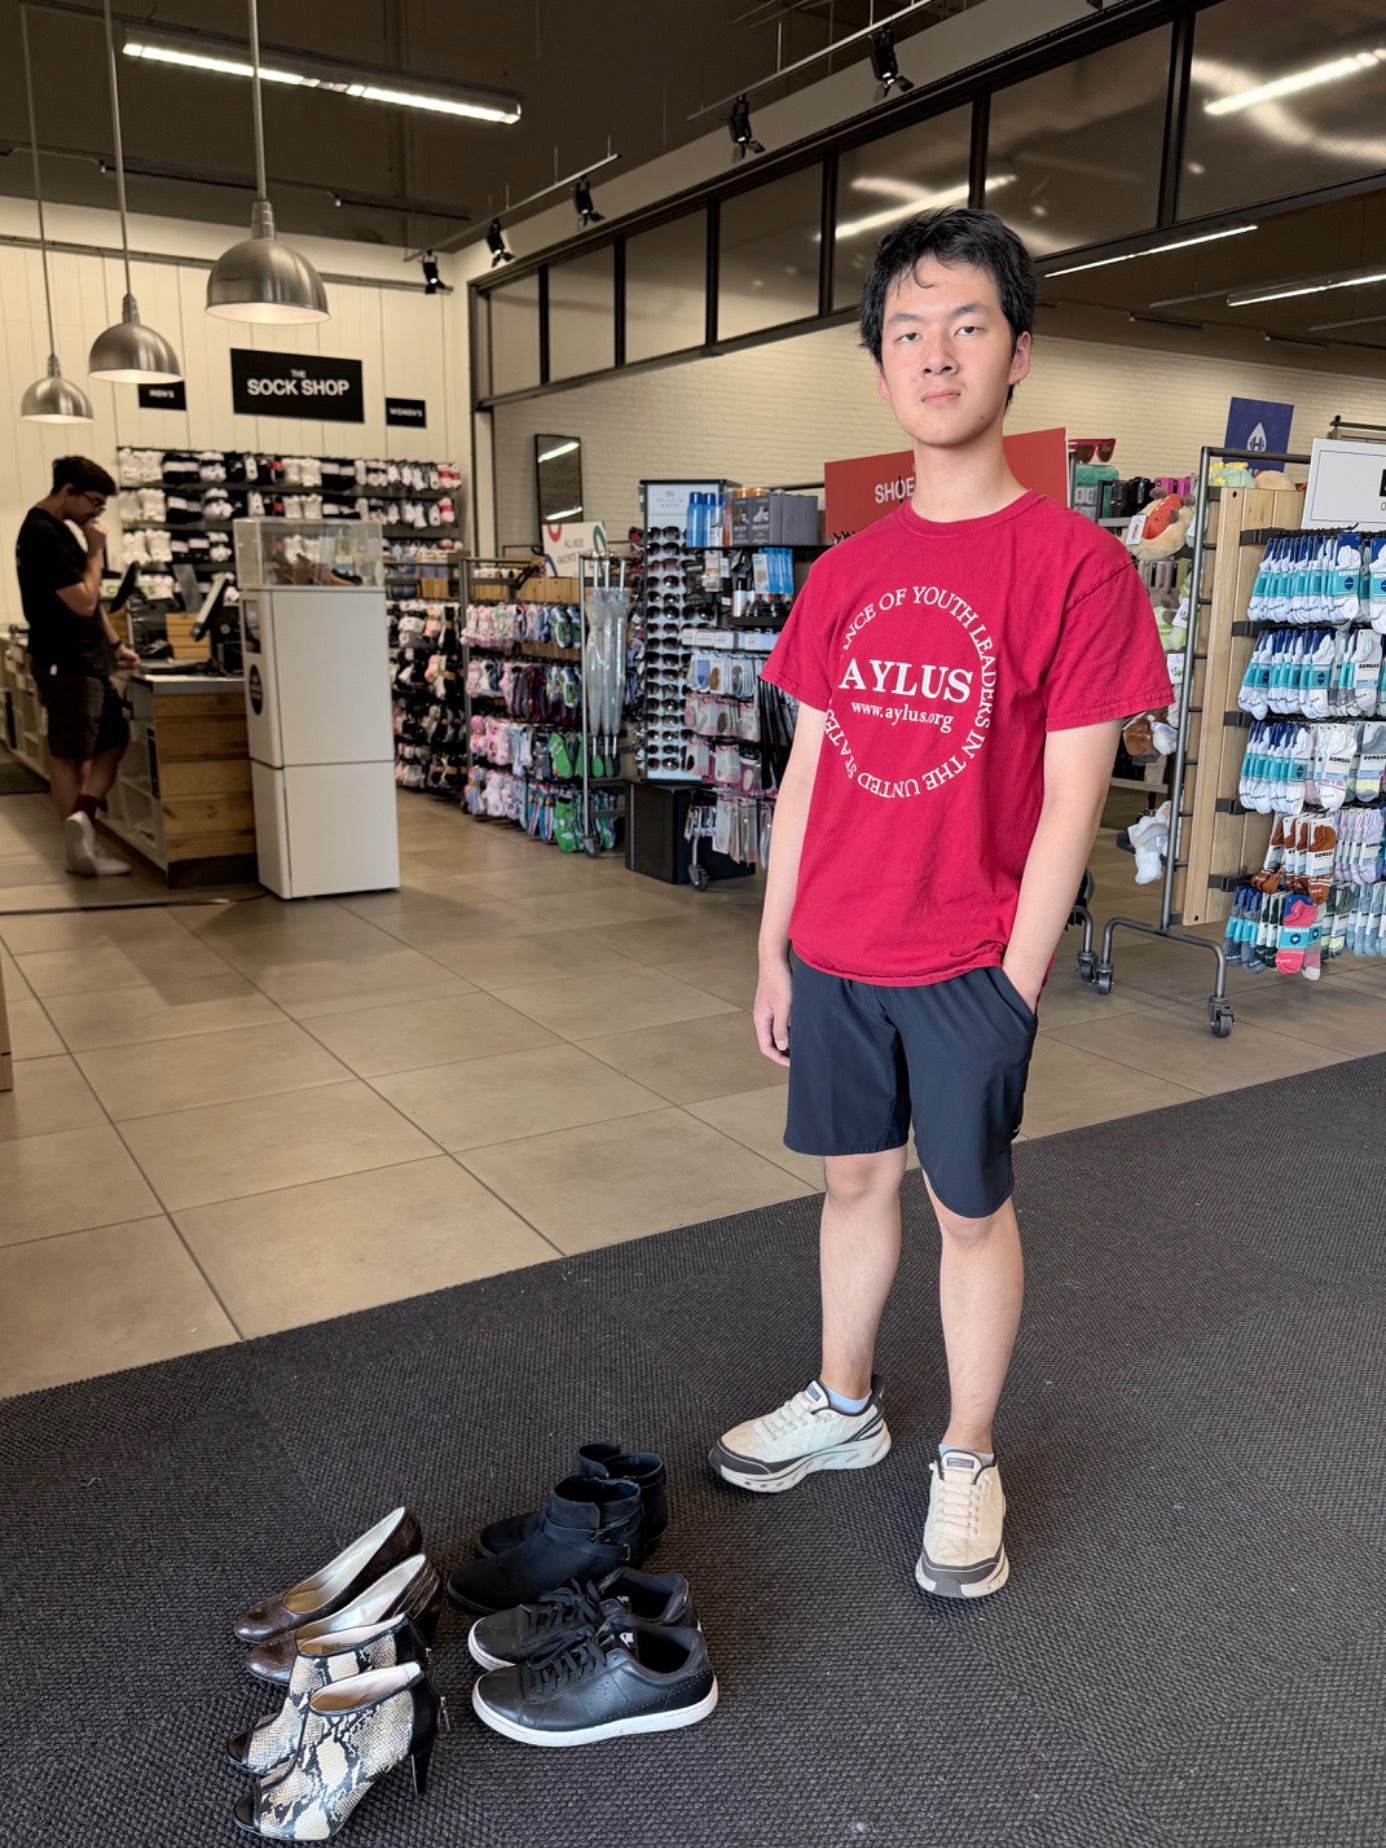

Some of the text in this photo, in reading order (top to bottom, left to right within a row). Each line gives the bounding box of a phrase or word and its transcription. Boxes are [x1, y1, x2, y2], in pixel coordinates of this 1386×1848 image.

[246, 378, 350, 396] SOCK SHOP
[290, 368, 307, 379] THE
[878, 588, 908, 611] OF
[912, 586, 980, 630] YOUTH
[838, 658, 973, 703] AYLUS
[968, 623, 997, 729] LEADERS
[850, 702, 954, 734] www.aylus.org
[961, 729, 986, 760] IN
[921, 755, 967, 791] THE
